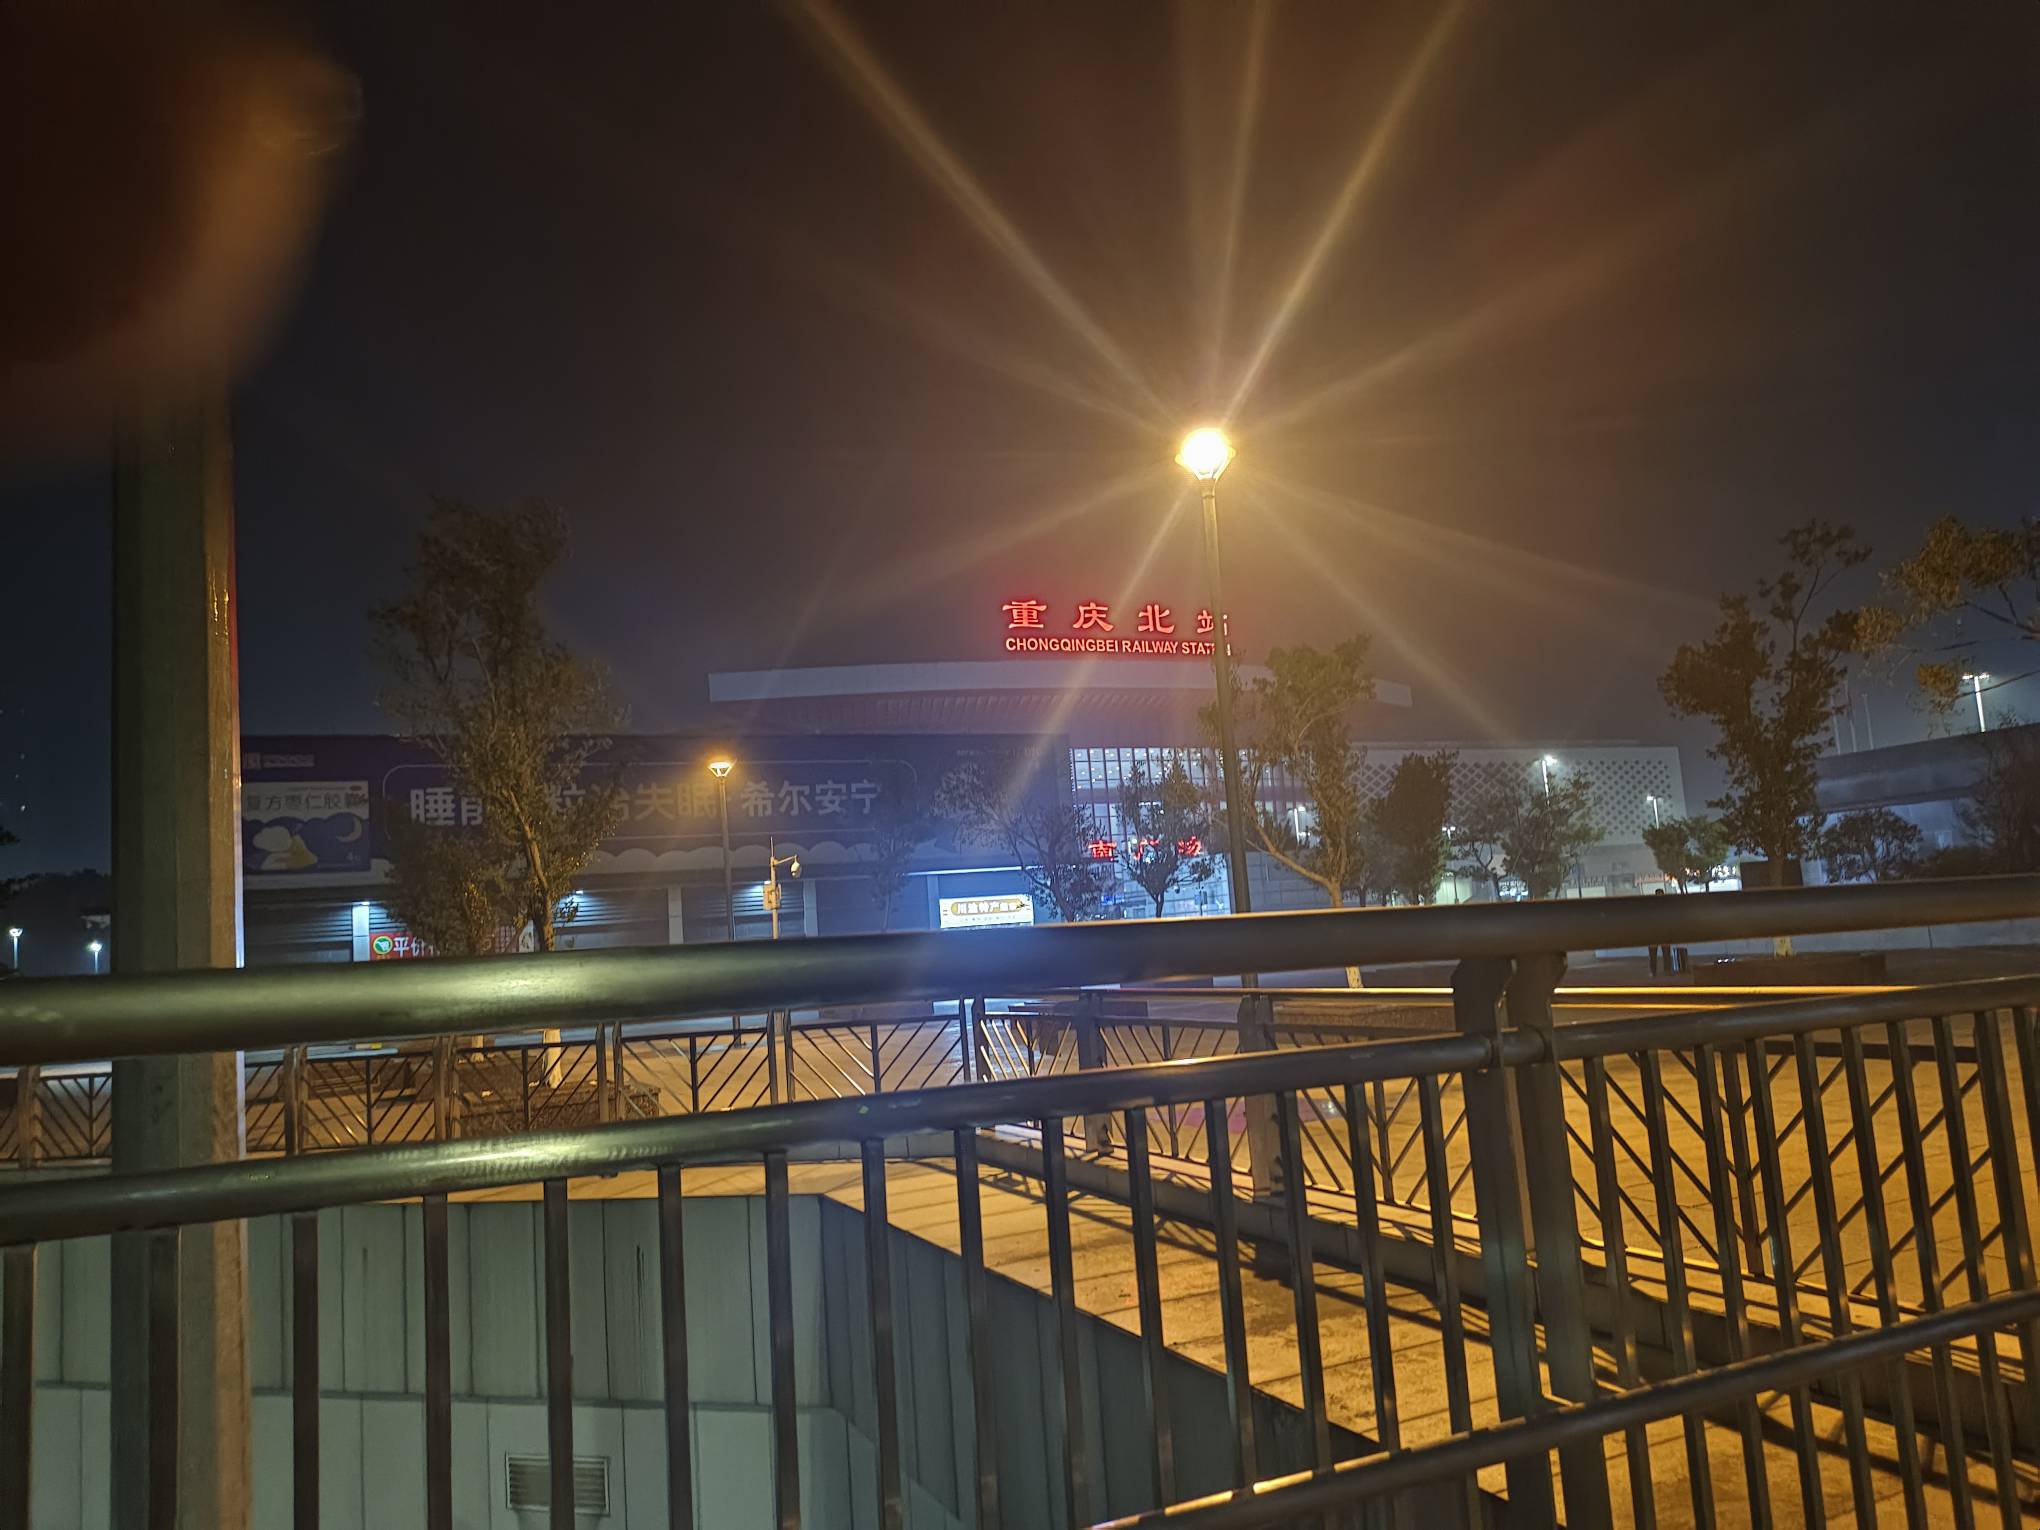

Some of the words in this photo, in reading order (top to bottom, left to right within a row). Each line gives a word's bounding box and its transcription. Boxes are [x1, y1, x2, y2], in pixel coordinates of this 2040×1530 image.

[1005, 637, 1118, 653] CHONGQINGBEI
[1122, 640, 1179, 655] RAILWAY
[740, 780, 878, 816] 希尔安宁
